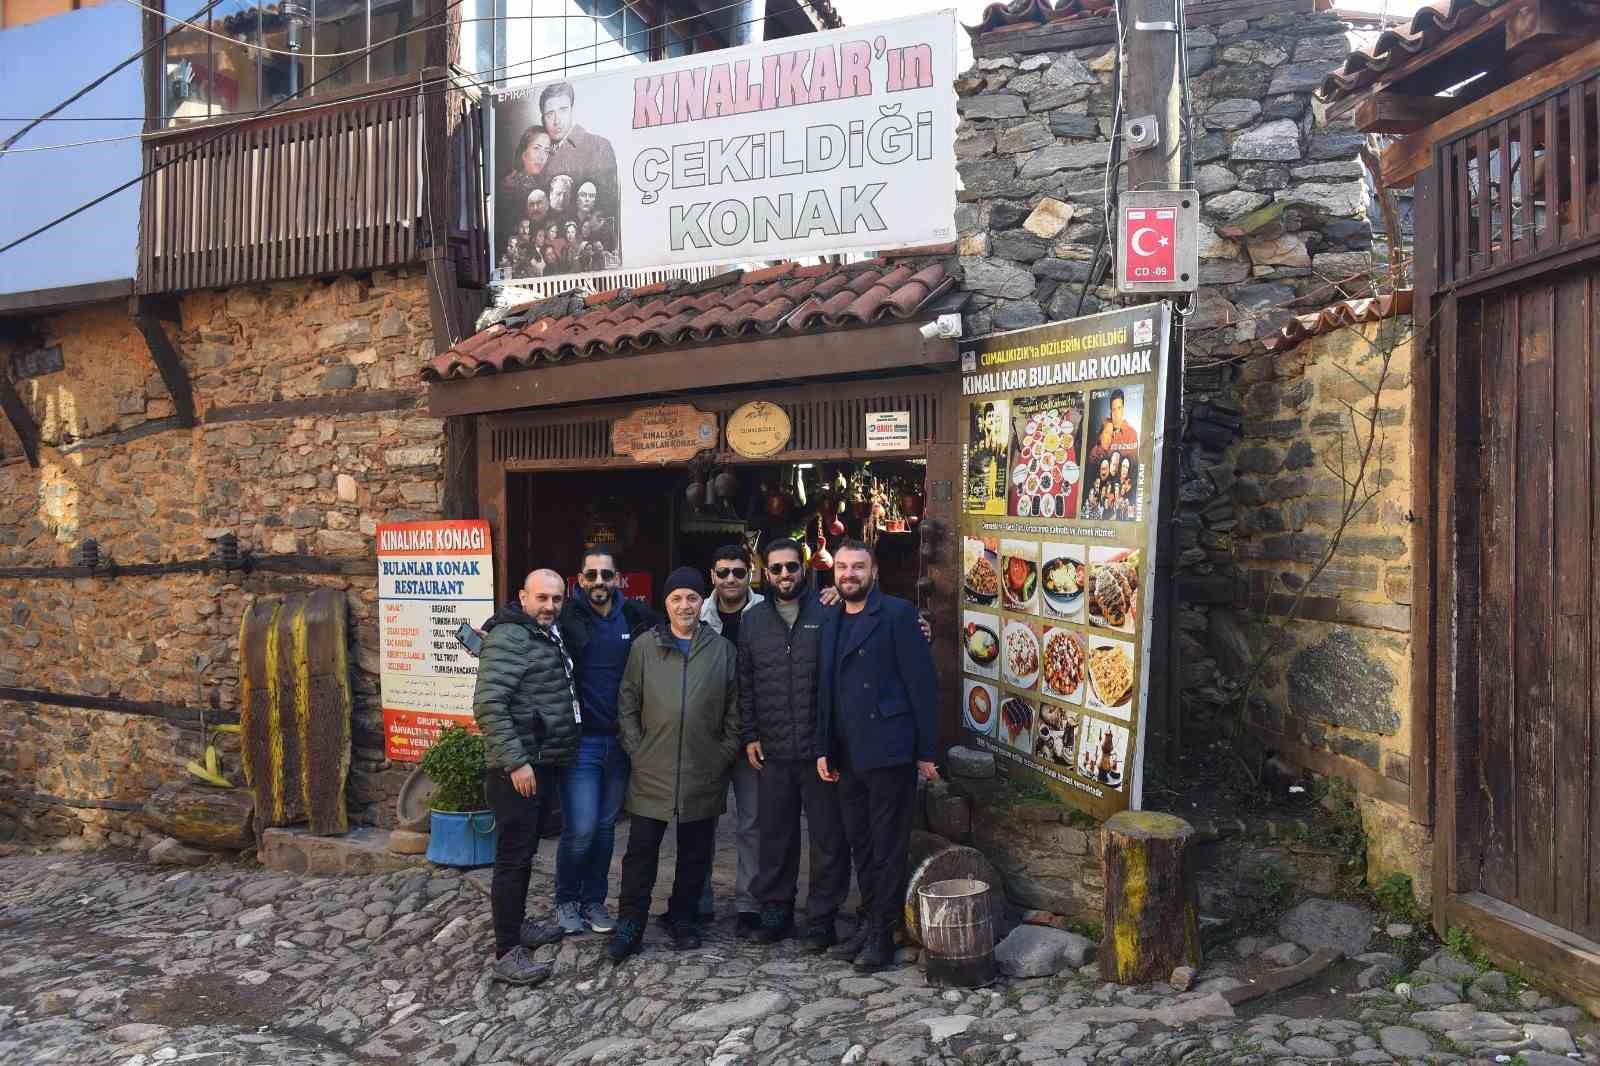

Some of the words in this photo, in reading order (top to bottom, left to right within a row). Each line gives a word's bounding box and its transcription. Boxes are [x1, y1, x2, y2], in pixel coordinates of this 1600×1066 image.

[670, 182, 887, 251] KONAK
[1135, 267, 1149, 276] CD
[961, 371, 1000, 396] KINALI
[1000, 367, 1027, 391] KAR
[1029, 359, 1098, 388] BULANLAR
[1100, 350, 1152, 378] KONAK
[381, 529, 433, 550] KINALIKAR
[436, 527, 485, 549] KONAĞI
[383, 561, 433, 575] BULANLAR
[436, 561, 480, 575] KONAK
[395, 580, 464, 595] RESTAURANT
[432, 605, 456, 613] BREAKFAST
[432, 617, 451, 625] TURKISH
[444, 654, 458, 662] TROUT
[435, 666, 453, 674] TURKISH
